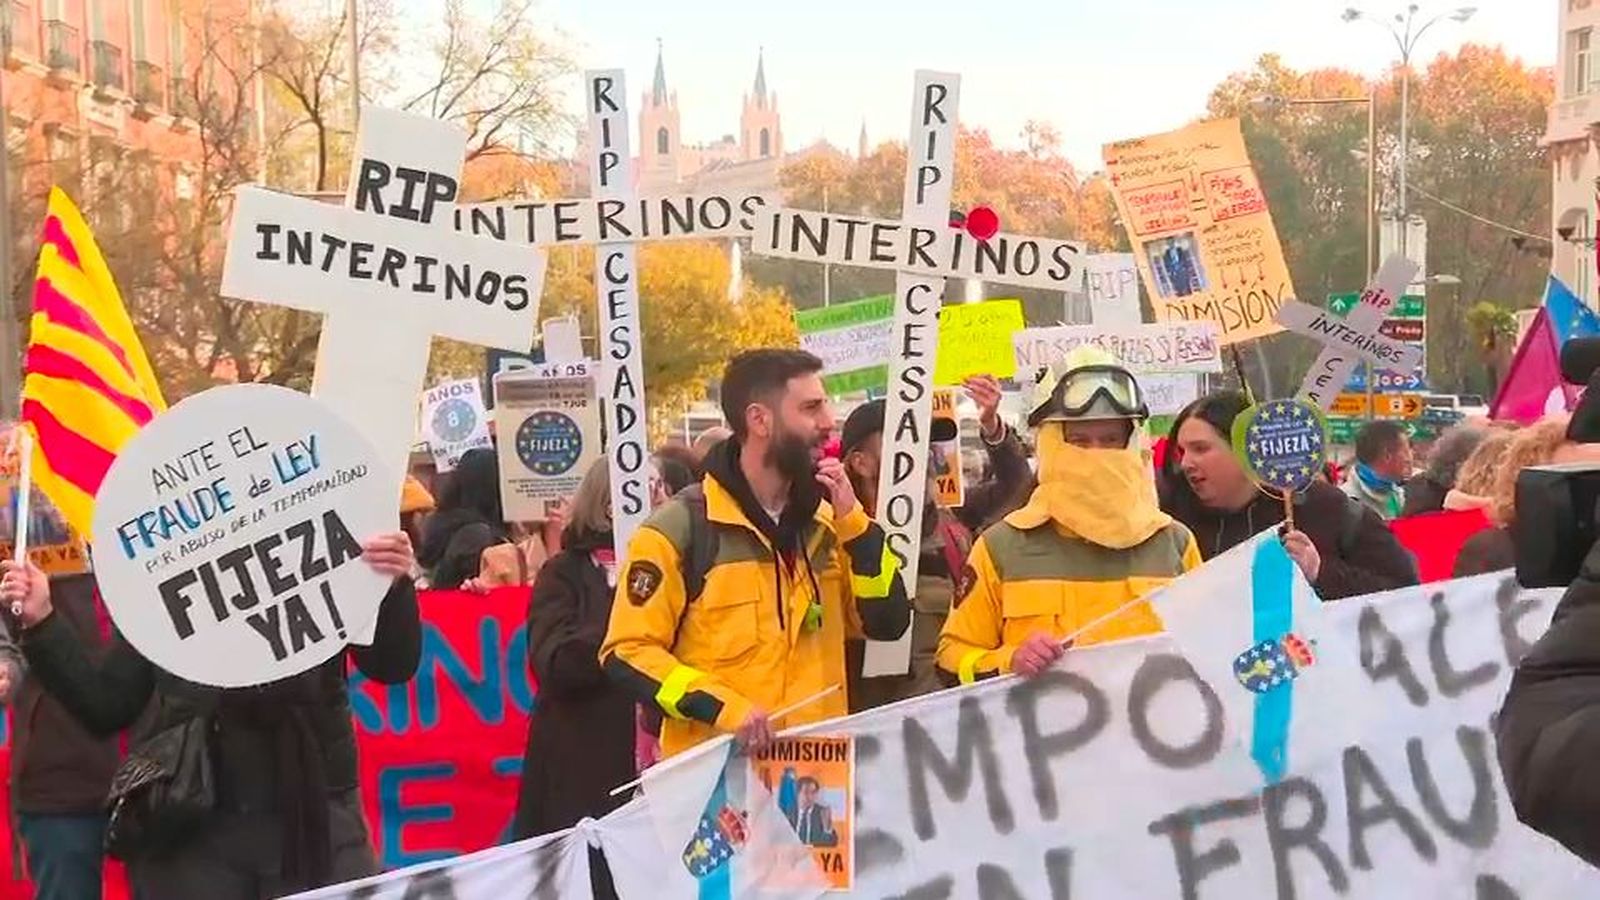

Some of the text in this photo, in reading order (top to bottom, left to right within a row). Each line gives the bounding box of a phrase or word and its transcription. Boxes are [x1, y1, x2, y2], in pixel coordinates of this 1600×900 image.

[593, 76, 620, 187] RIP
[919, 84, 948, 205] RIP
[355, 158, 457, 223] RIP
[255, 223, 530, 312] INTERINOS
[771, 212, 1078, 282] INTERINOS
[603, 251, 644, 518] CESADOS
[151, 426, 268, 493] ANTE EL
[530, 438, 571, 451] FIJEZA
[886, 284, 932, 572] CESADOS
[1260, 434, 1311, 457] FIJEZA
[115, 434, 322, 560] FRAUDE de LEY
[937, 478, 956, 493] YA
[180, 527, 226, 556] ABUSO
[231, 514, 249, 533] DE
[158, 509, 364, 641] FIJEZA
[820, 853, 844, 873] YA
